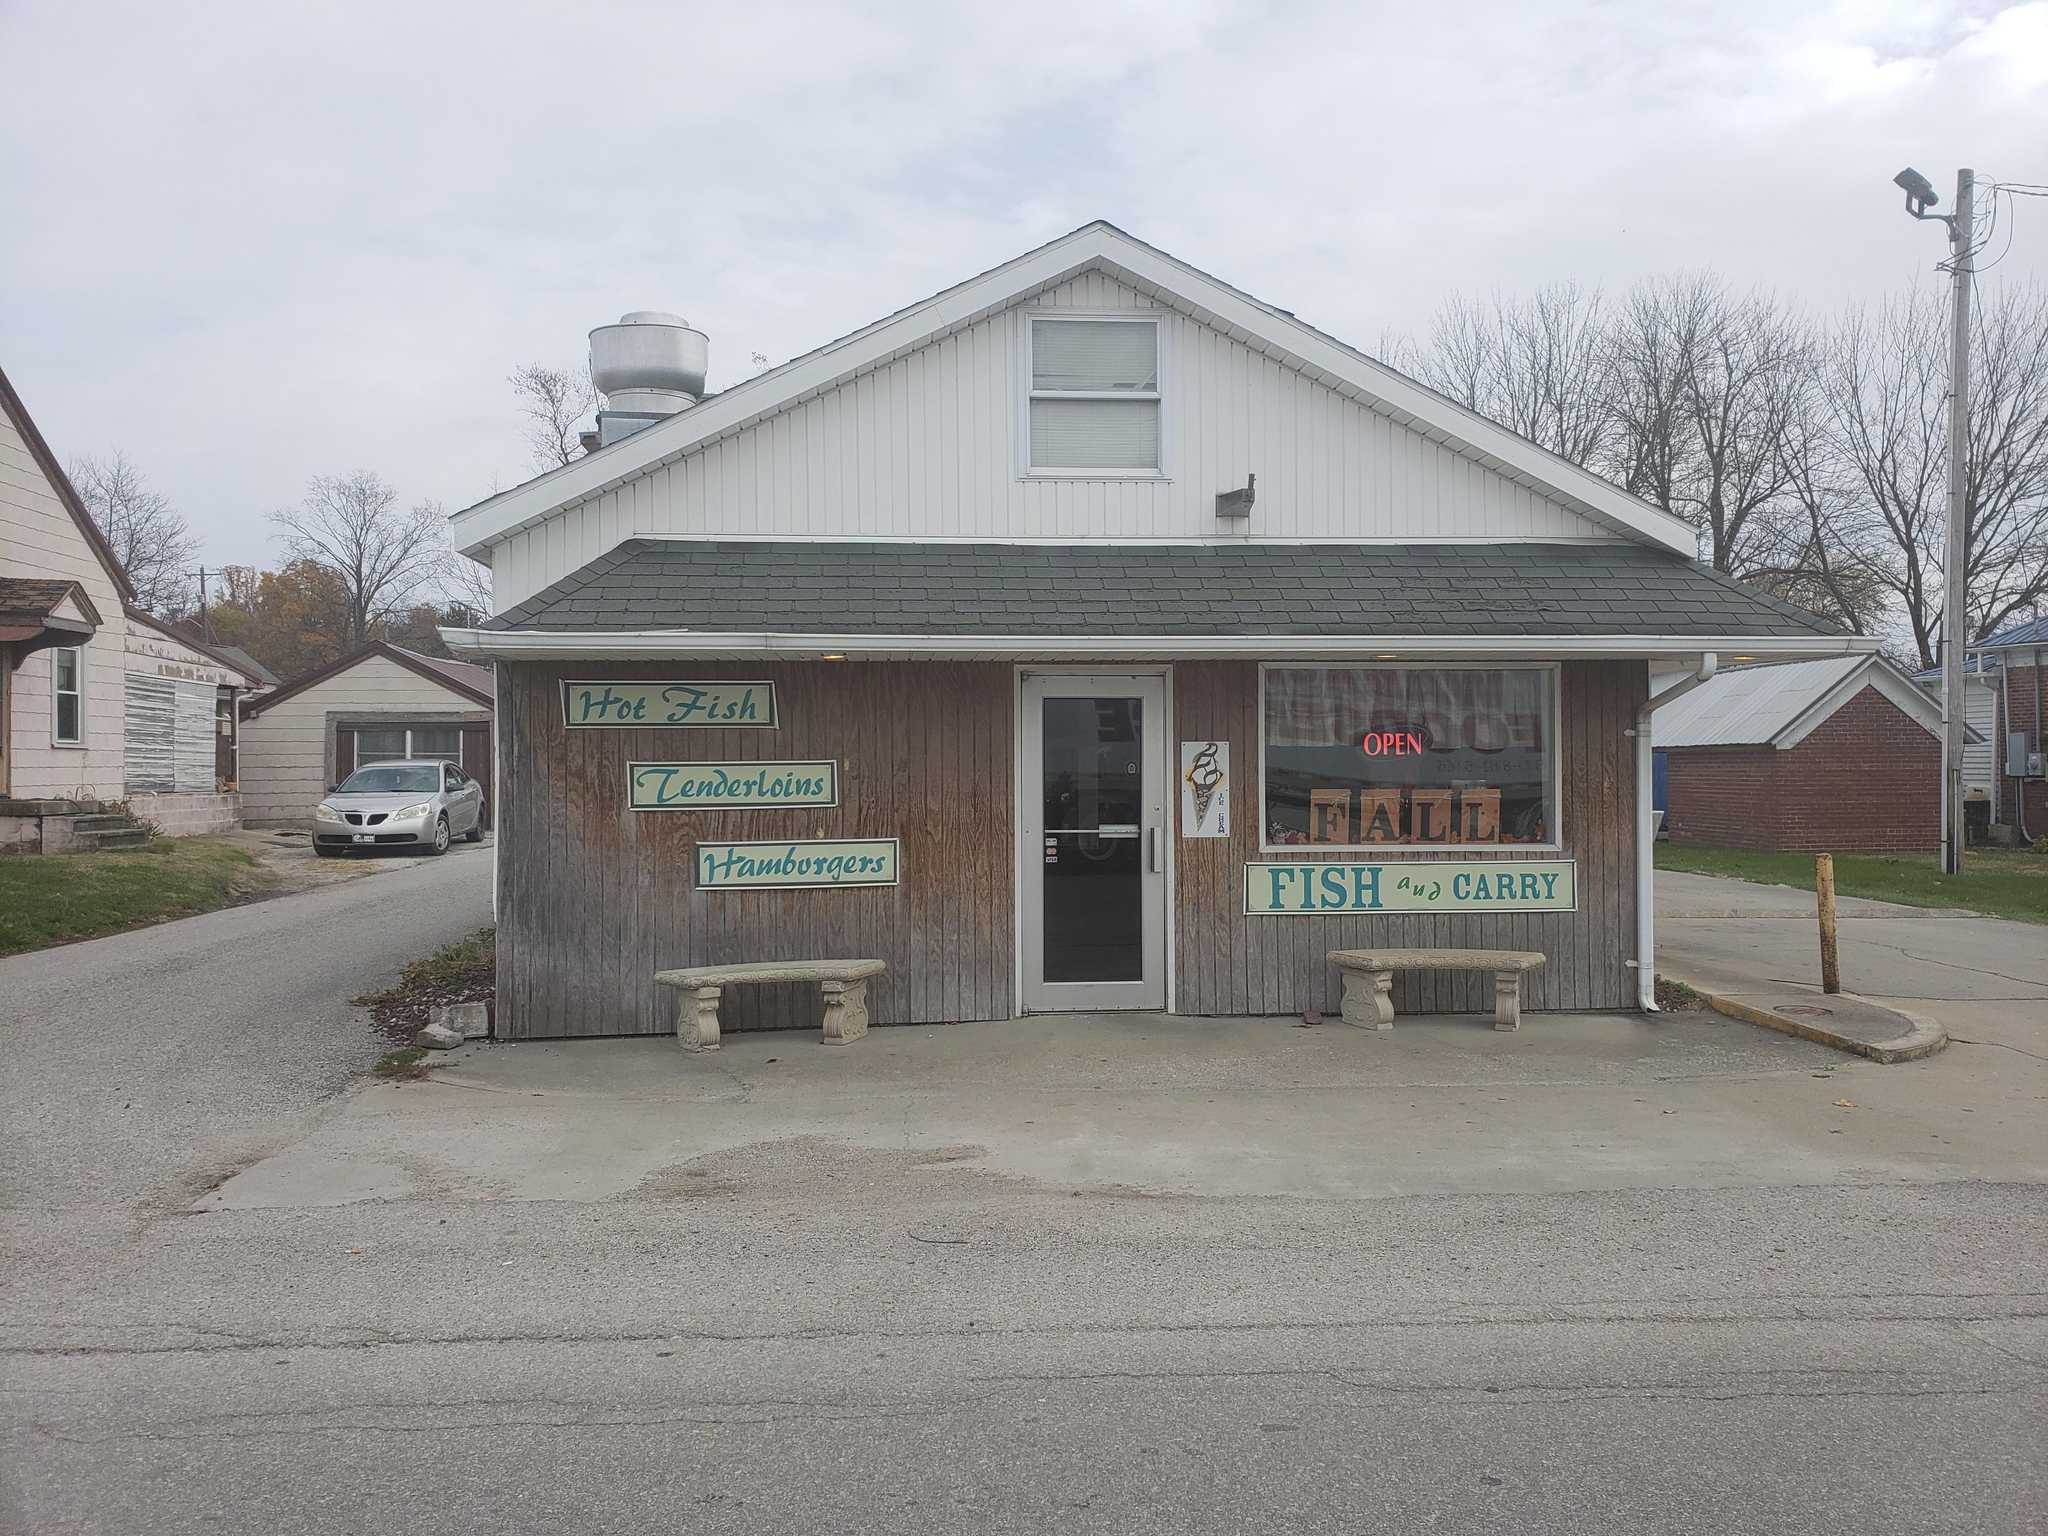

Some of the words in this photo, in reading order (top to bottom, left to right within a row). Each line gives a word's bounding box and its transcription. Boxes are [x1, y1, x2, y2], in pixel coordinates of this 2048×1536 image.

[580, 687, 646, 721] Hot
[663, 687, 756, 722] Fish
[1363, 732, 1423, 756] OPEN
[636, 768, 824, 804] Tenderloins
[1314, 802, 1496, 842] FALL
[703, 846, 887, 884] Hamburgers
[1268, 866, 1384, 909] FISH
[1397, 876, 1441, 901] and
[1452, 872, 1560, 901] CARRY
